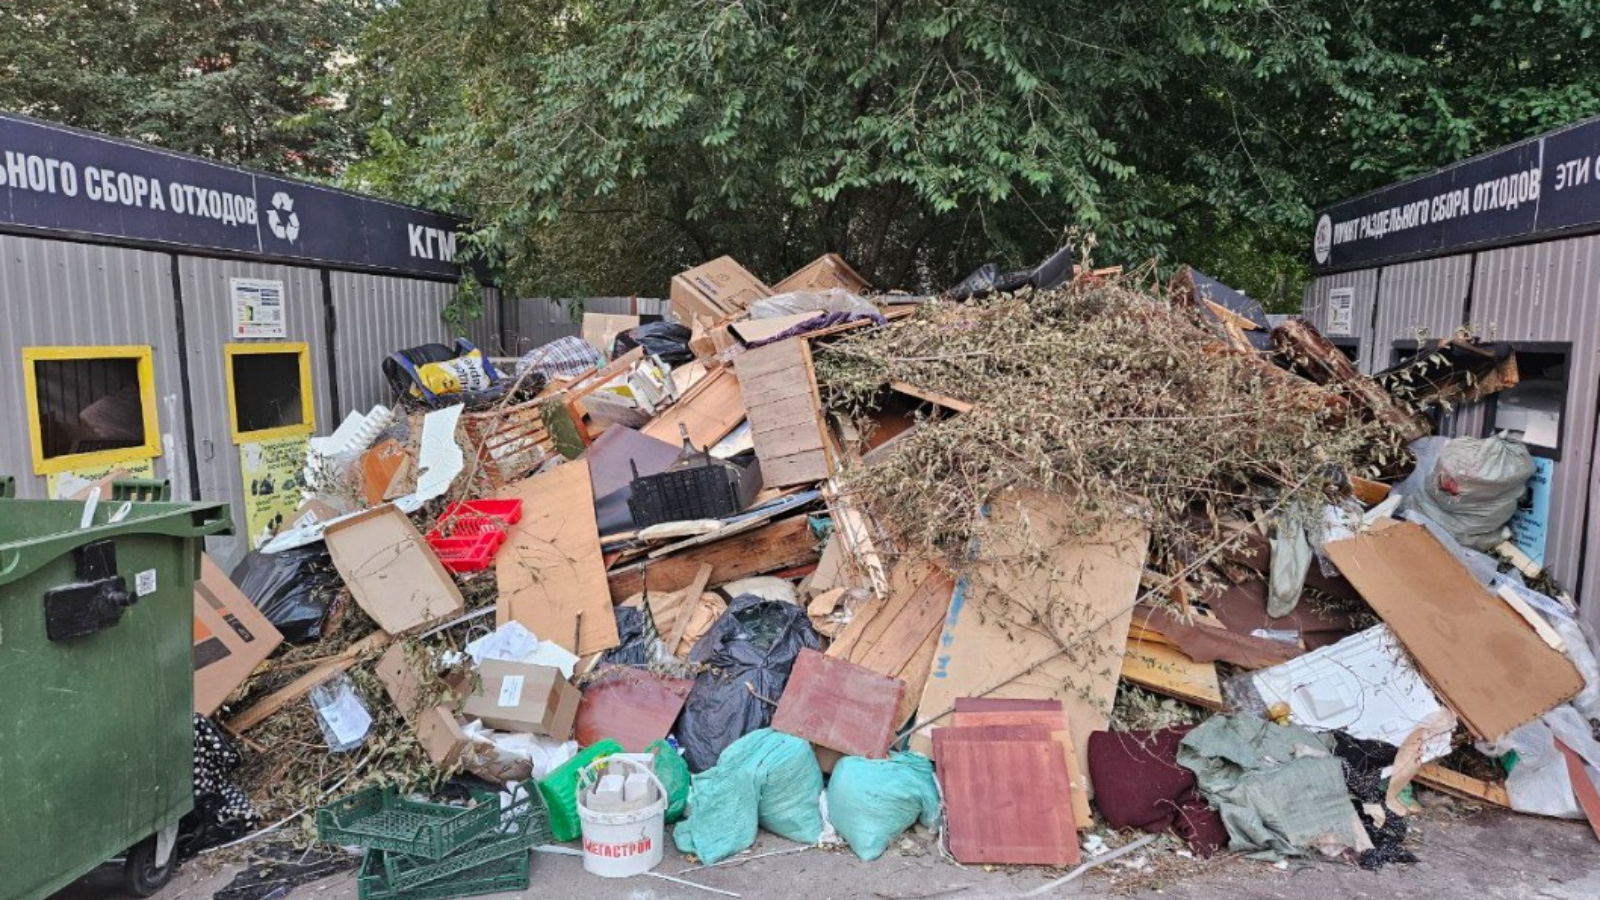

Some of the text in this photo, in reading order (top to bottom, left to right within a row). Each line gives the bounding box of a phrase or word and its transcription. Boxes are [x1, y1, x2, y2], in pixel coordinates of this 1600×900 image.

[84, 166, 166, 211] СБОРА
[169, 182, 258, 227] ОТХОДОВ
[1555, 156, 1590, 191] ЭТИ
[1333, 168, 1541, 246] ПУНКТ РАЗДЕЛЬНОГО СБОРА ОТХОДОВ
[408, 223, 456, 262] КГМ
